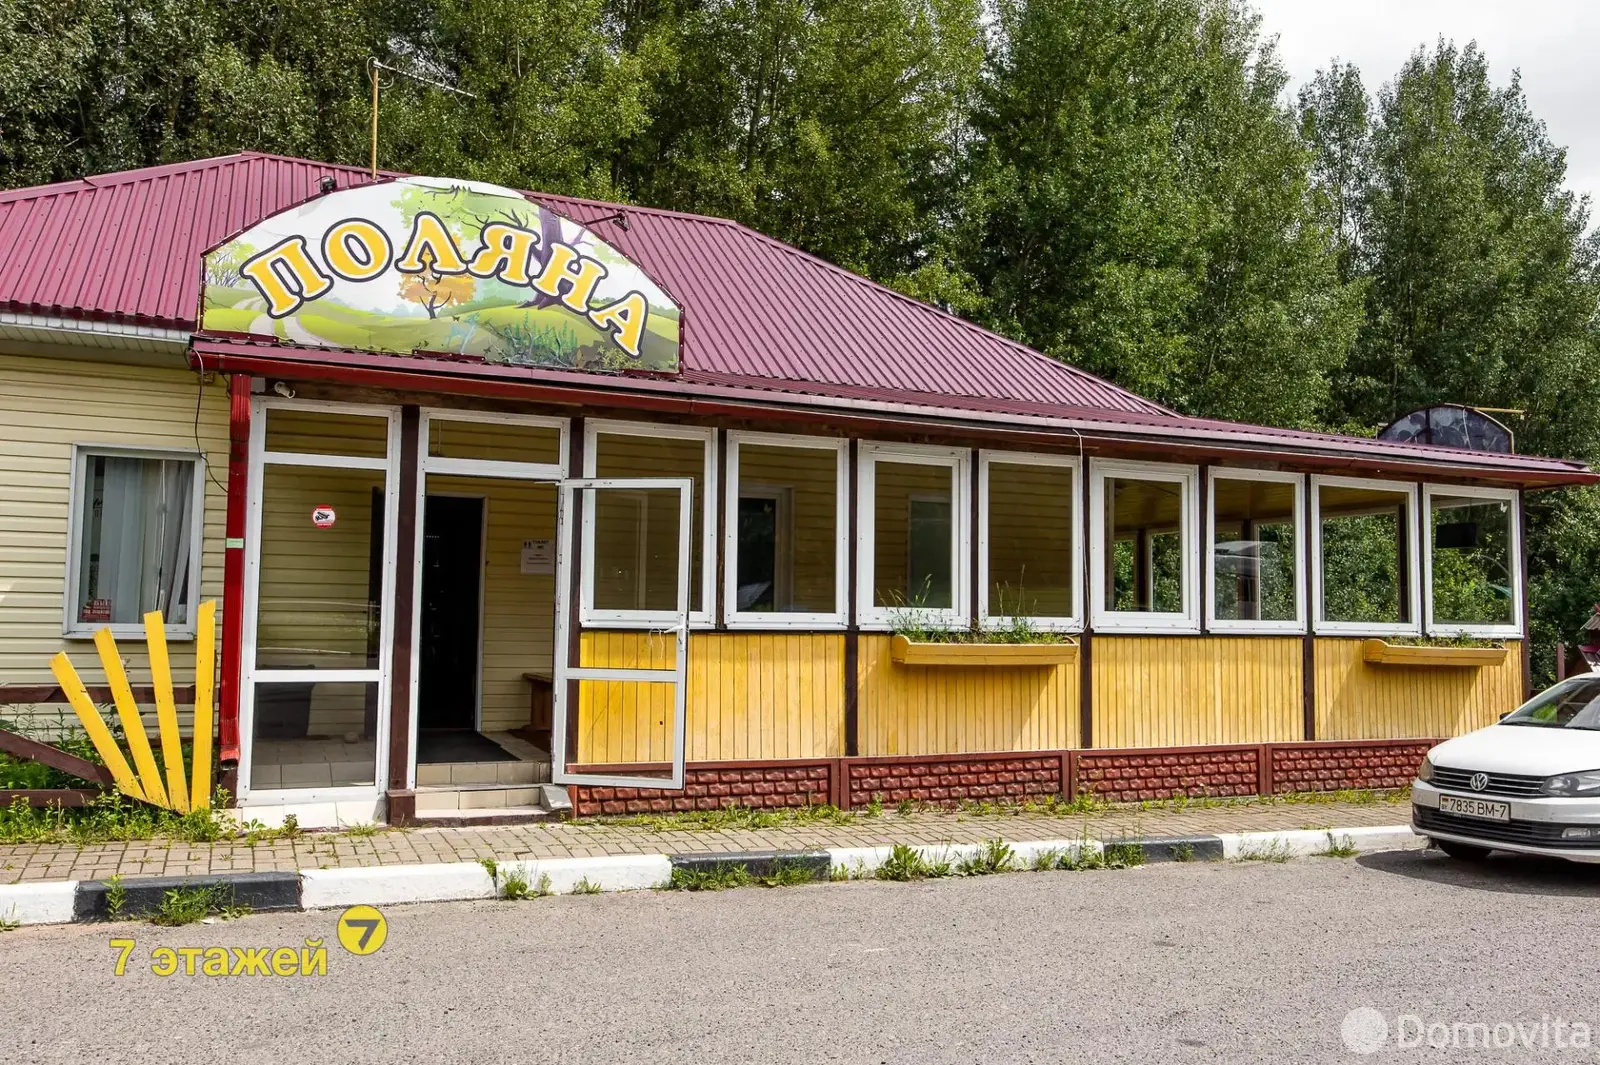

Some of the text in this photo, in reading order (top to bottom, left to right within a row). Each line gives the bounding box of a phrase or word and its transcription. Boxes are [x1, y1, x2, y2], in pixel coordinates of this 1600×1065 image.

[240, 213, 648, 357] ПОЛЯНА
[1450, 799, 1506, 817] 7835 BM-7
